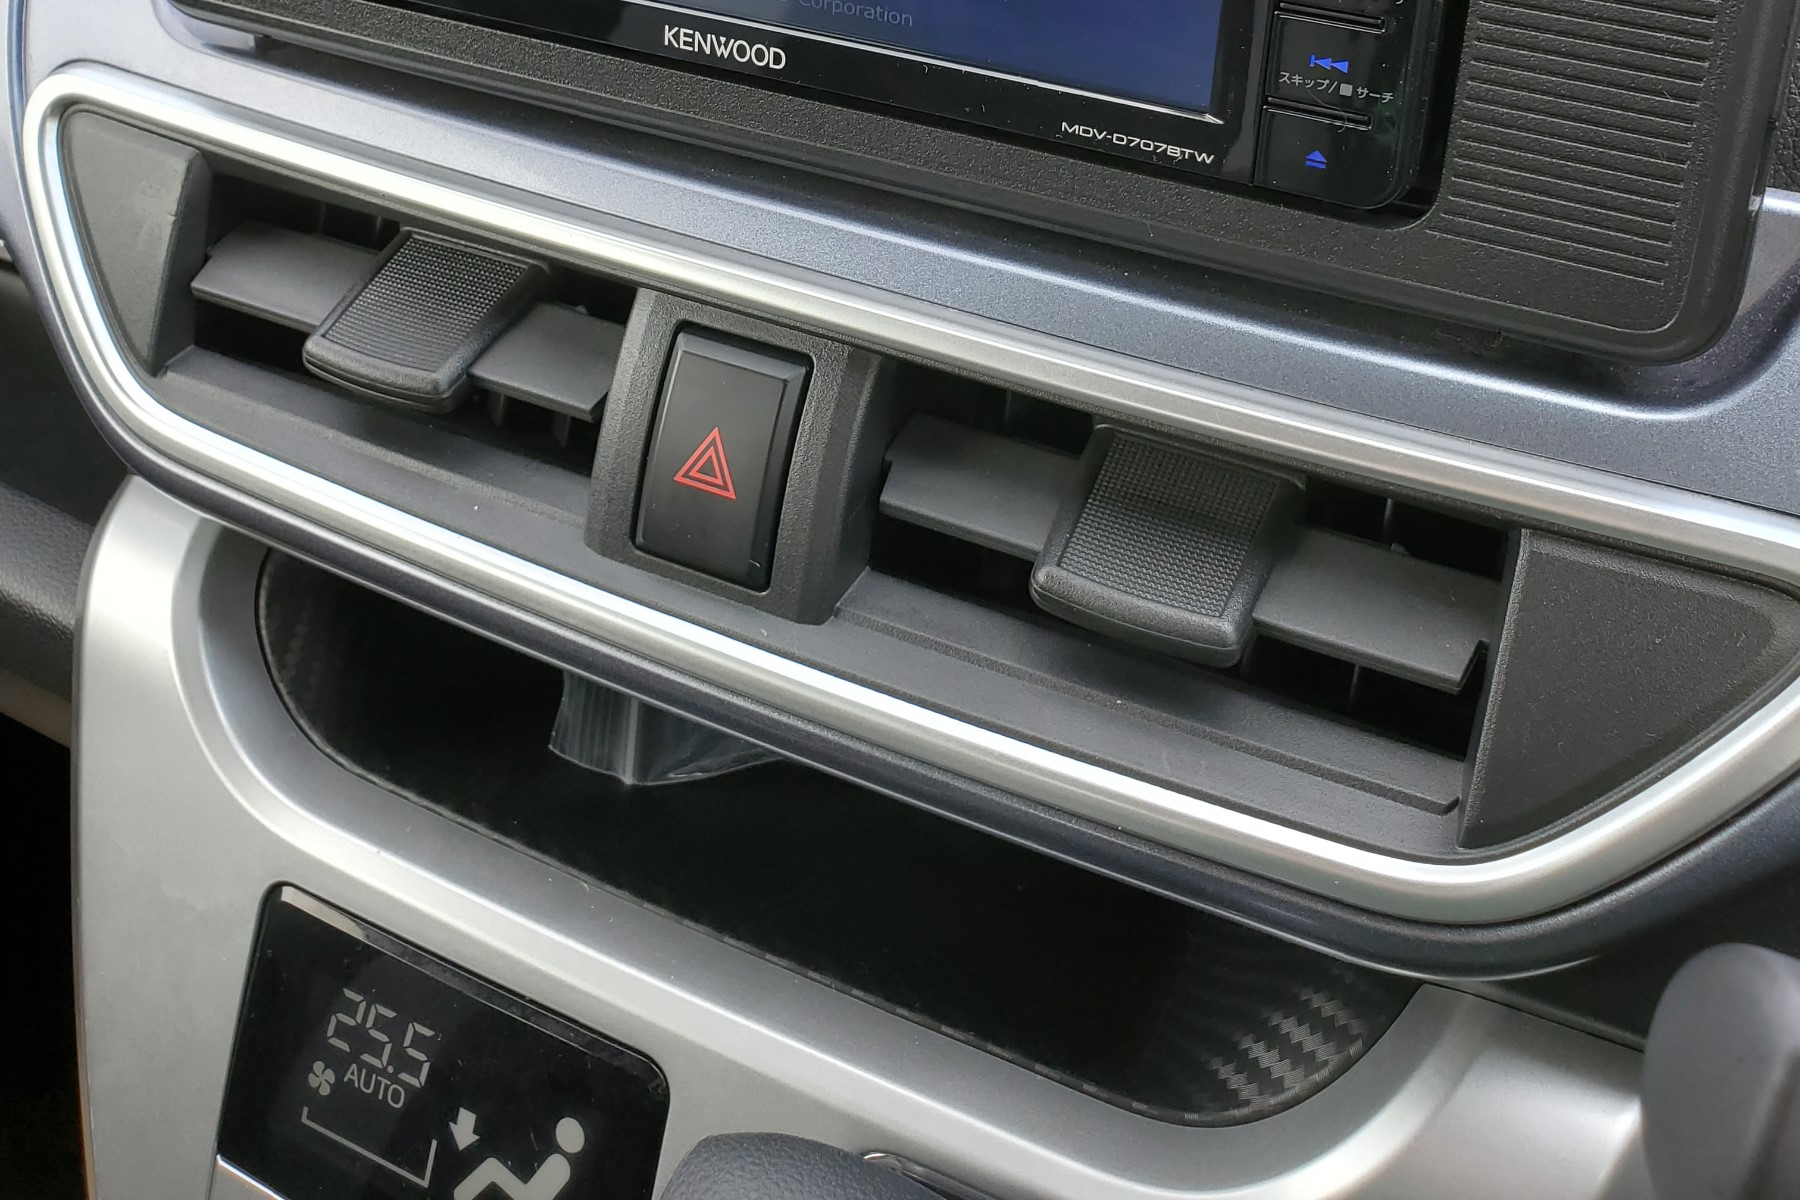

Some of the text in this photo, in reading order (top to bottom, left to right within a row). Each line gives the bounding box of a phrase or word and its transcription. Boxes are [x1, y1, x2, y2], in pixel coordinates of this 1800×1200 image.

[664, 24, 787, 71] KENWOOD
[1061, 121, 1215, 165] MDV-D707BTW
[325, 987, 437, 1089] 25.5
[343, 1063, 406, 1110] AUTO
